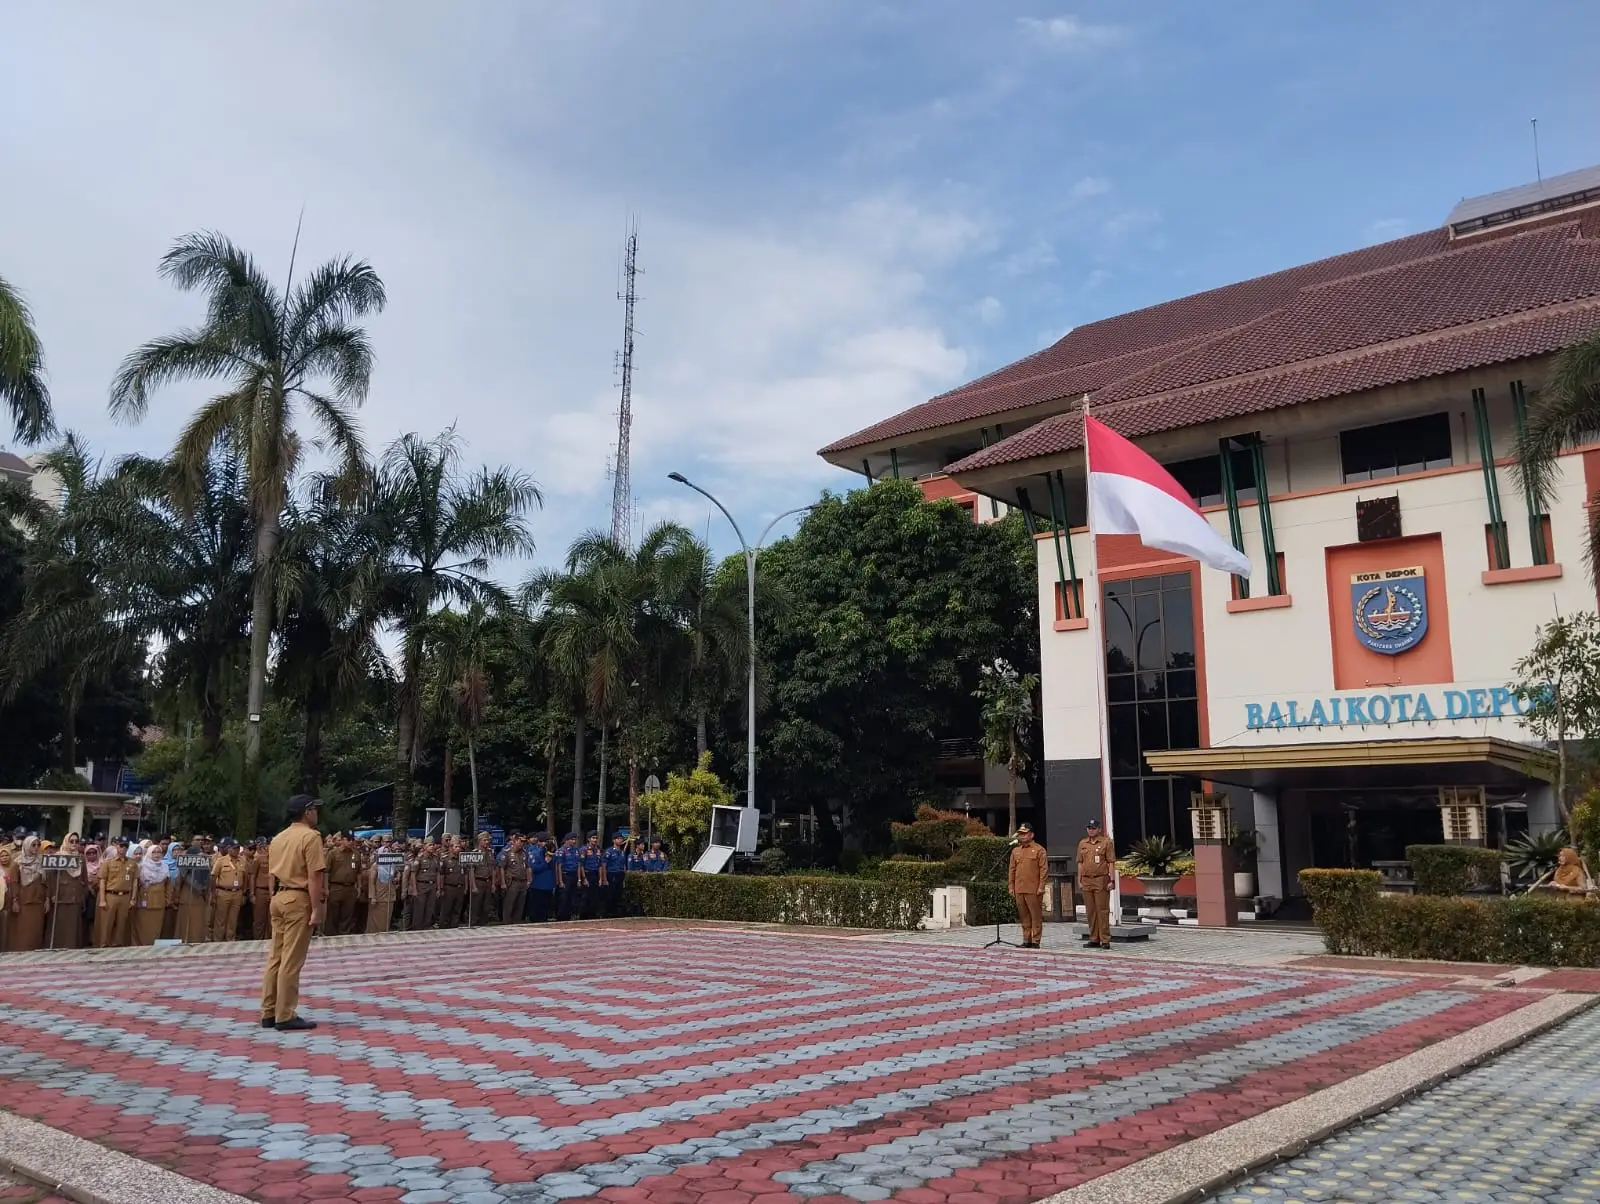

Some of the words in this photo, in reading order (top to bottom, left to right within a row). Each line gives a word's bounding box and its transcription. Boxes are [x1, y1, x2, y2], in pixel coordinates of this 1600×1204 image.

[1356, 573, 1381, 582] KOTA
[1385, 569, 1417, 579] DEPOK
[42, 856, 78, 868] IRDA
[178, 856, 210, 867] BAPPEDA
